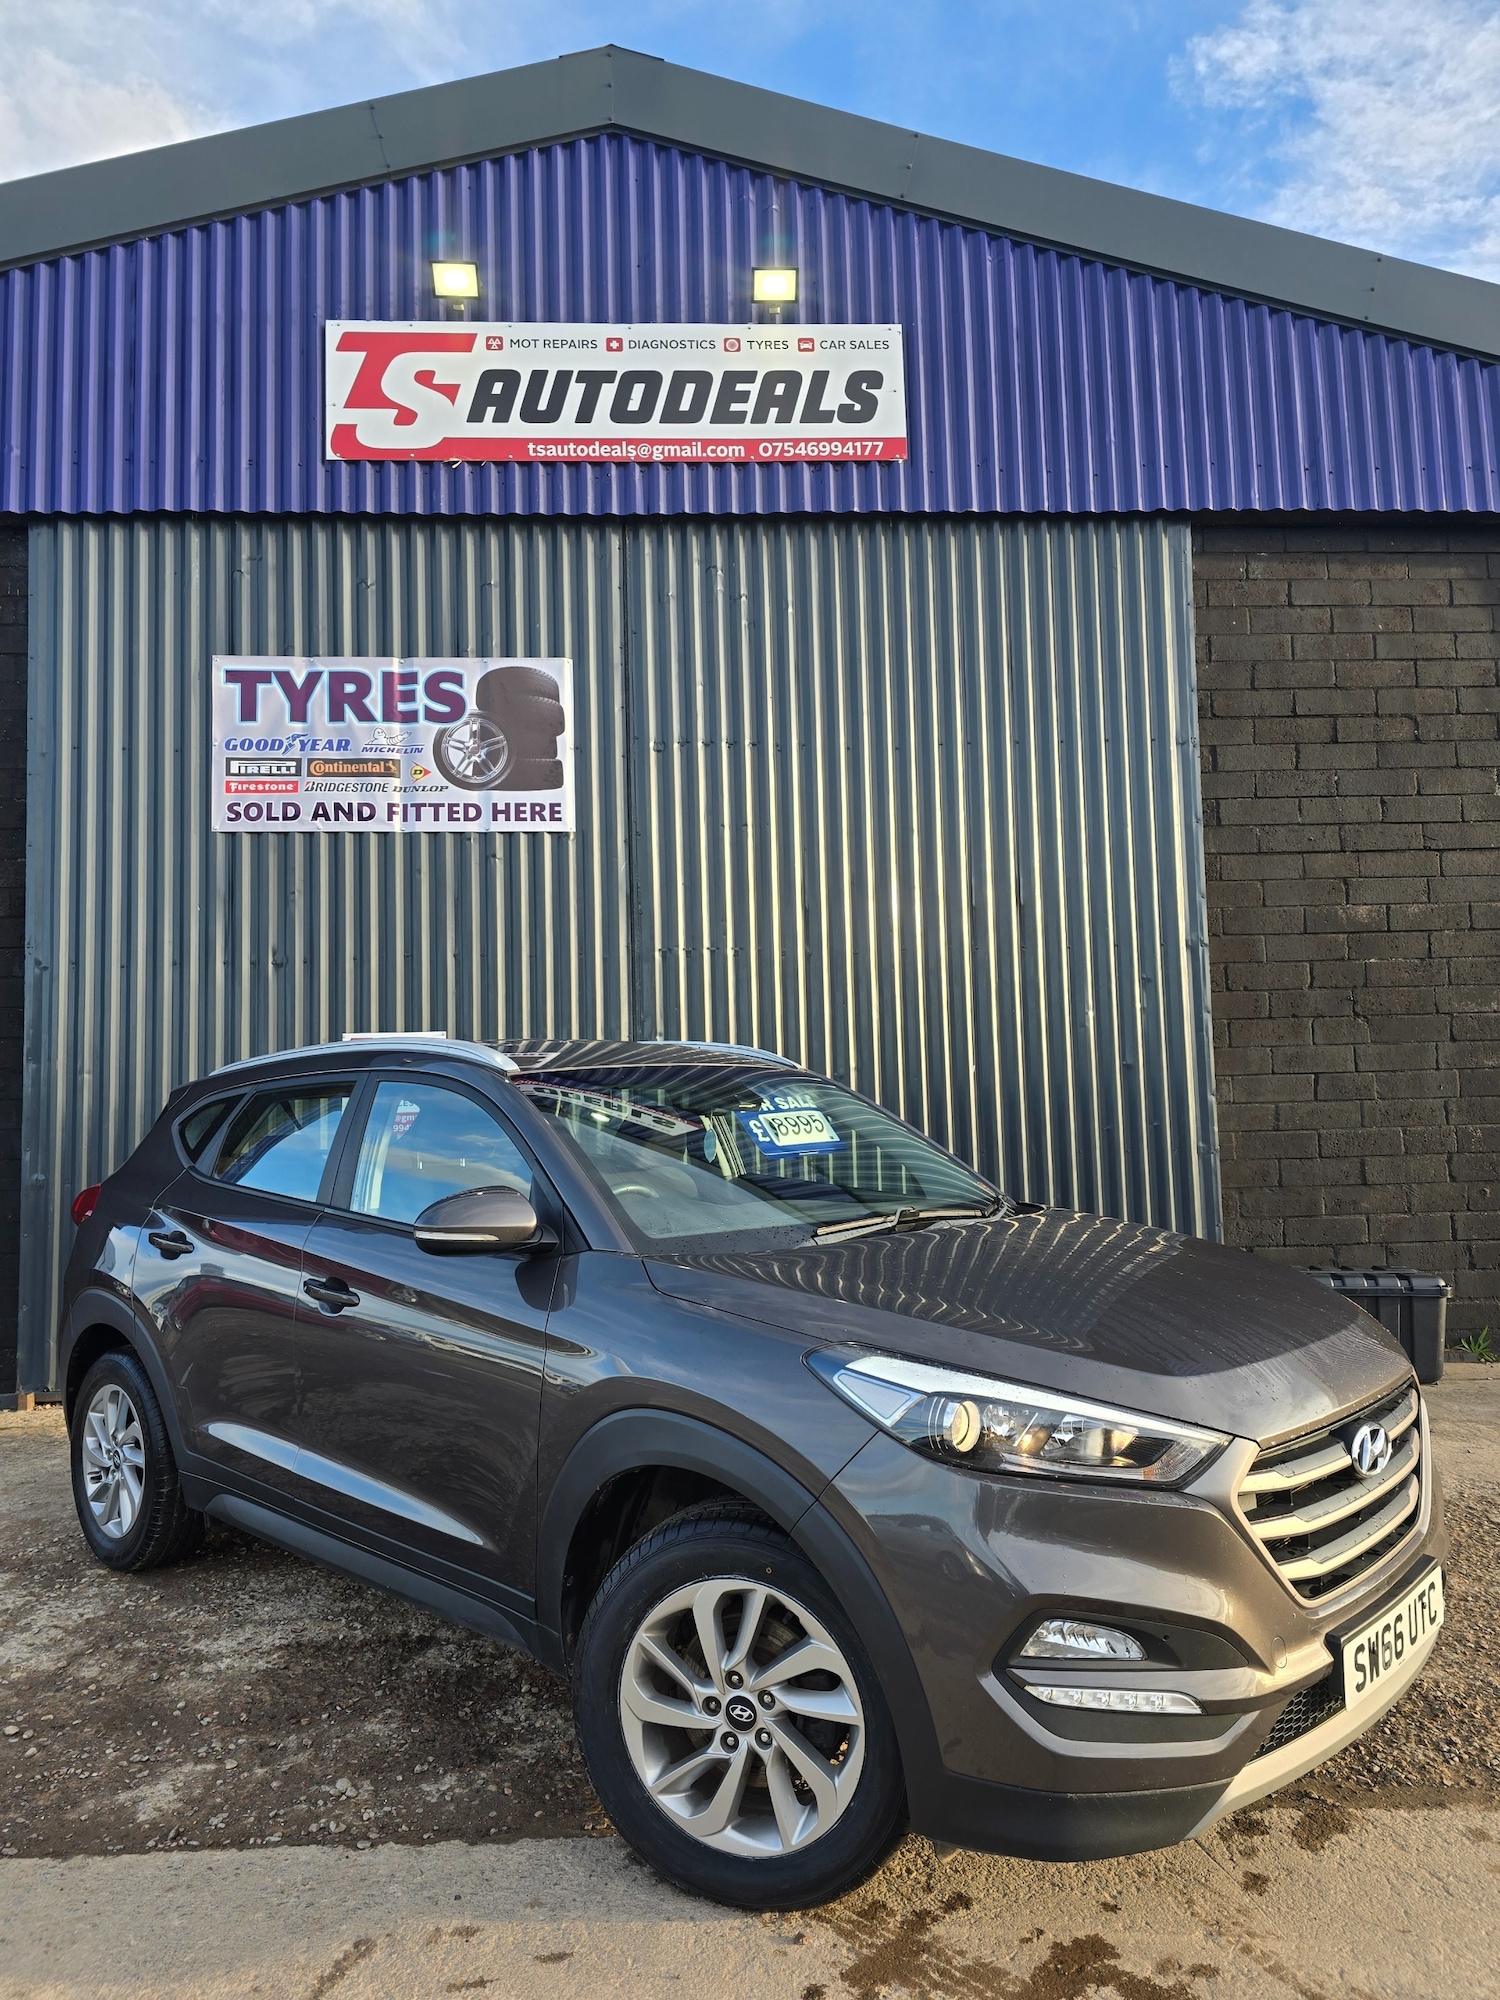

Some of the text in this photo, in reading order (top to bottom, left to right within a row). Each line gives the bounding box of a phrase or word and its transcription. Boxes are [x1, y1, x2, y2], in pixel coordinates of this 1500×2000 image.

[509, 338, 890, 350] MOT REPAIRS DIAGNOSTICS TYRES CAR SALES
[331, 331, 478, 449] TS
[466, 368, 884, 424] AUTODEALS
[527, 441, 884, 459] tsautodeals@gmail.com 07546994177
[225, 669, 467, 724] TYRES
[361, 746, 424, 754] MICHELIN
[229, 760, 297, 774] PIRELLI
[309, 760, 385, 776] Continental
[228, 781, 294, 792] Firestone
[304, 781, 389, 793] BRIDGESTONE
[392, 785, 449, 793] DUNLOP
[226, 801, 563, 823] SOLD AND FITTED HERE
[1354, 1612, 1405, 1694] SW66
